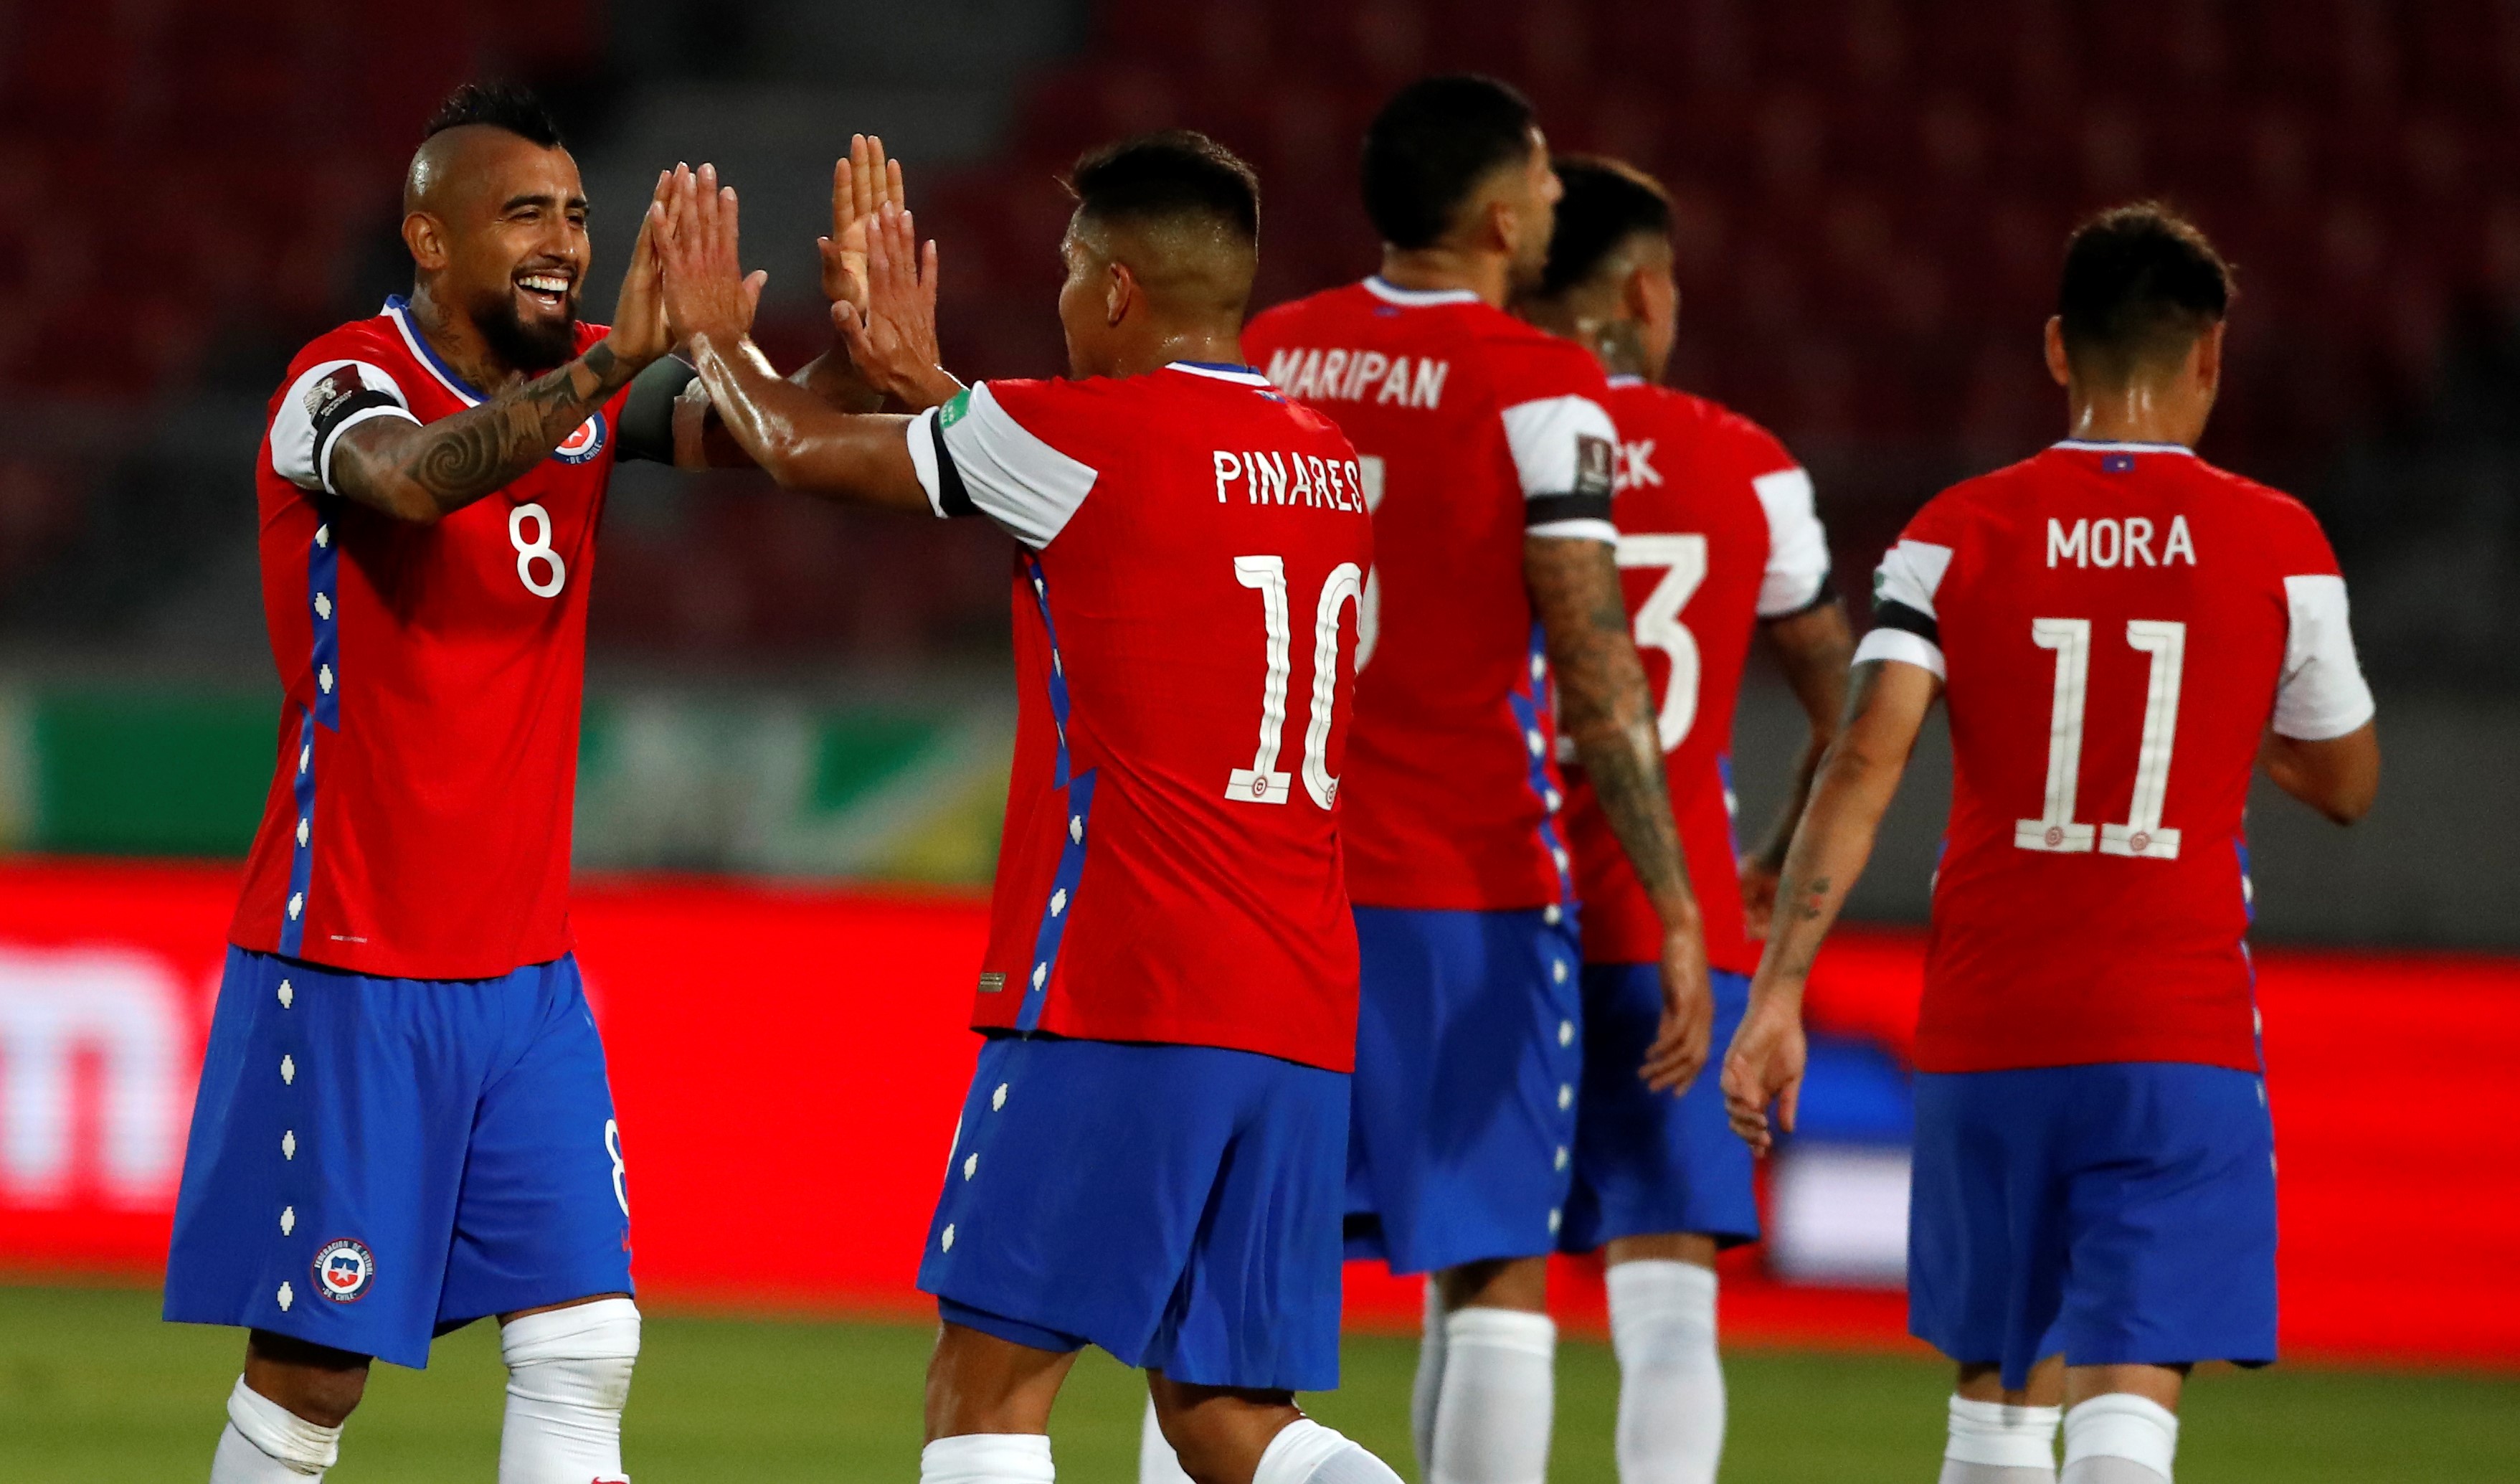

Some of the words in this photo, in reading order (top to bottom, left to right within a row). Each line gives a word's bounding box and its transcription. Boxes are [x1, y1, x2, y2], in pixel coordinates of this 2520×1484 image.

[1266, 346, 1449, 409] MARIPAN
[570, 455, 581, 464] DE
[584, 442, 603, 460] CHILE
[1213, 450, 1362, 514] PINARES
[509, 503, 566, 598] 8
[2046, 515, 2197, 568] MORA
[1224, 554, 1363, 810] 10
[2014, 617, 2187, 861] 11
[323, 1288, 333, 1298] DE
